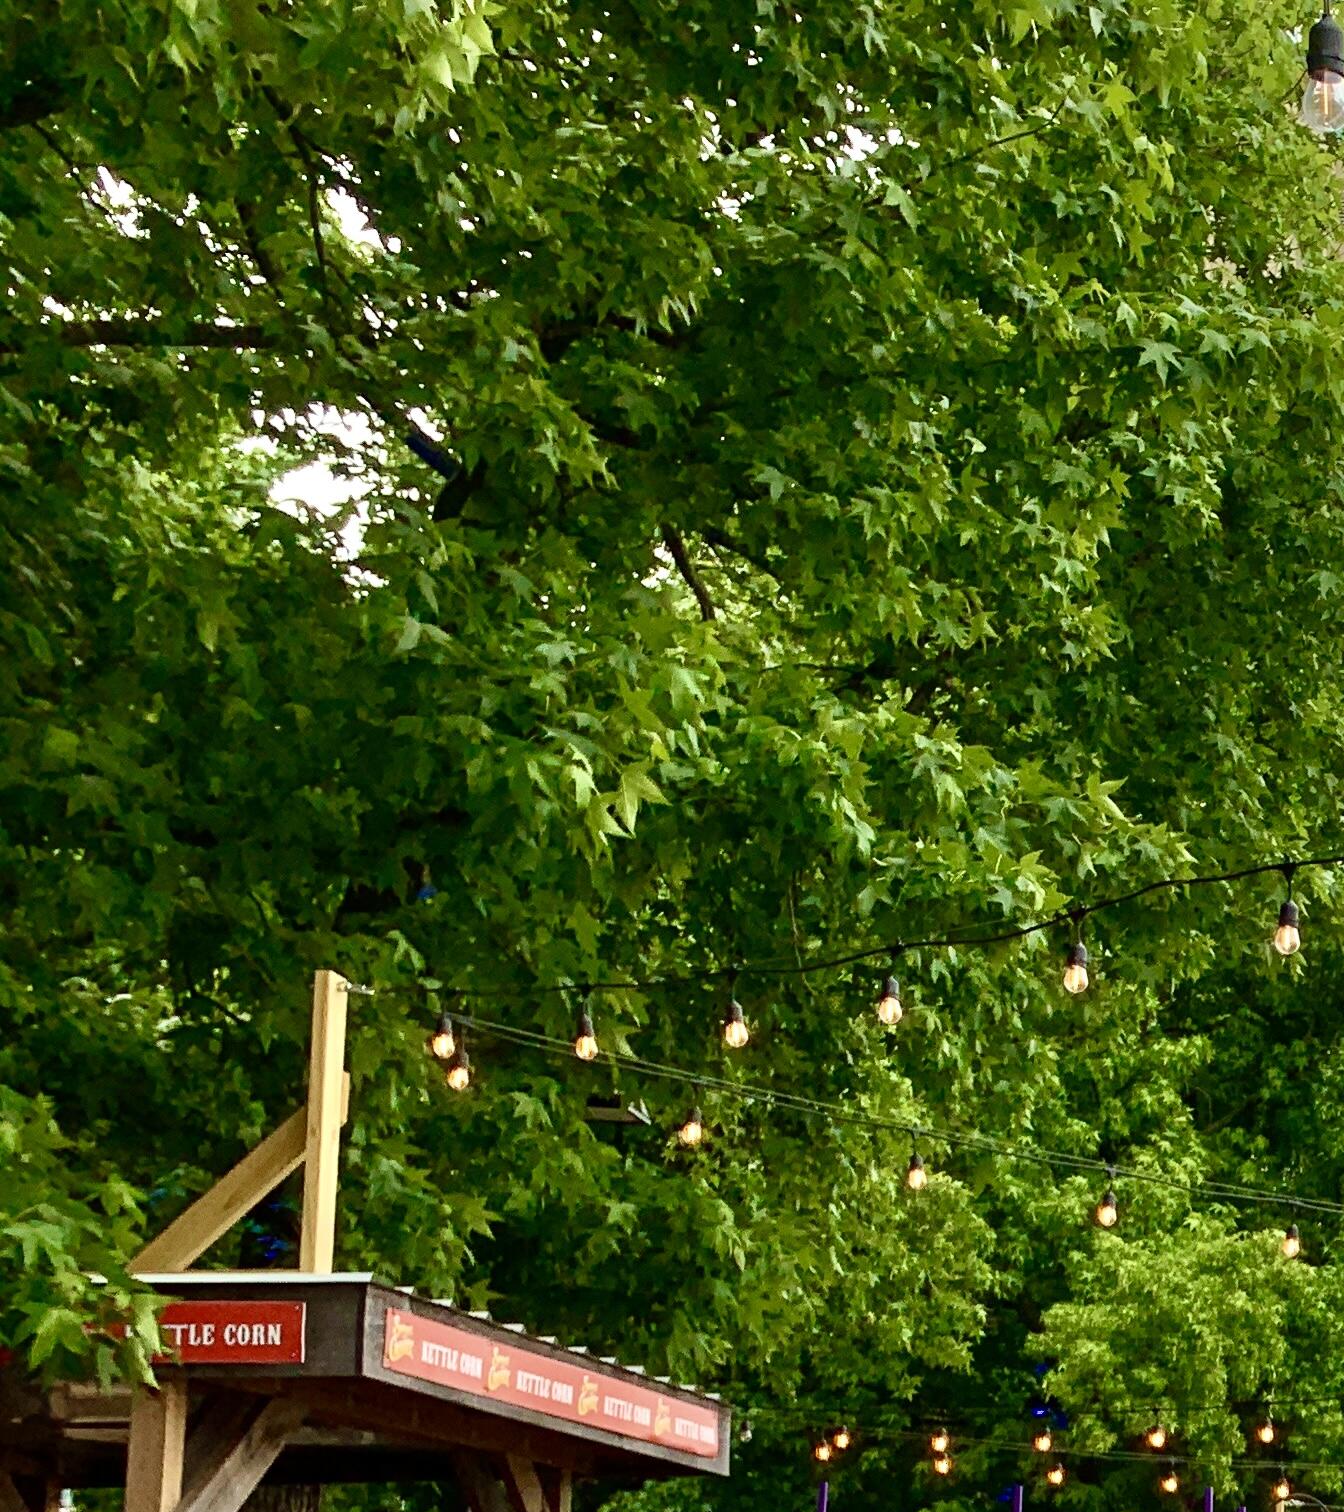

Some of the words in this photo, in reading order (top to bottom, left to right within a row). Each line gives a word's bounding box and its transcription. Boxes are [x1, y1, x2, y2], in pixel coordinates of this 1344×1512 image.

[223, 1323, 282, 1346] CORN
[421, 1340, 459, 1372] KETTLE
[516, 1370, 551, 1399] KETTLE
